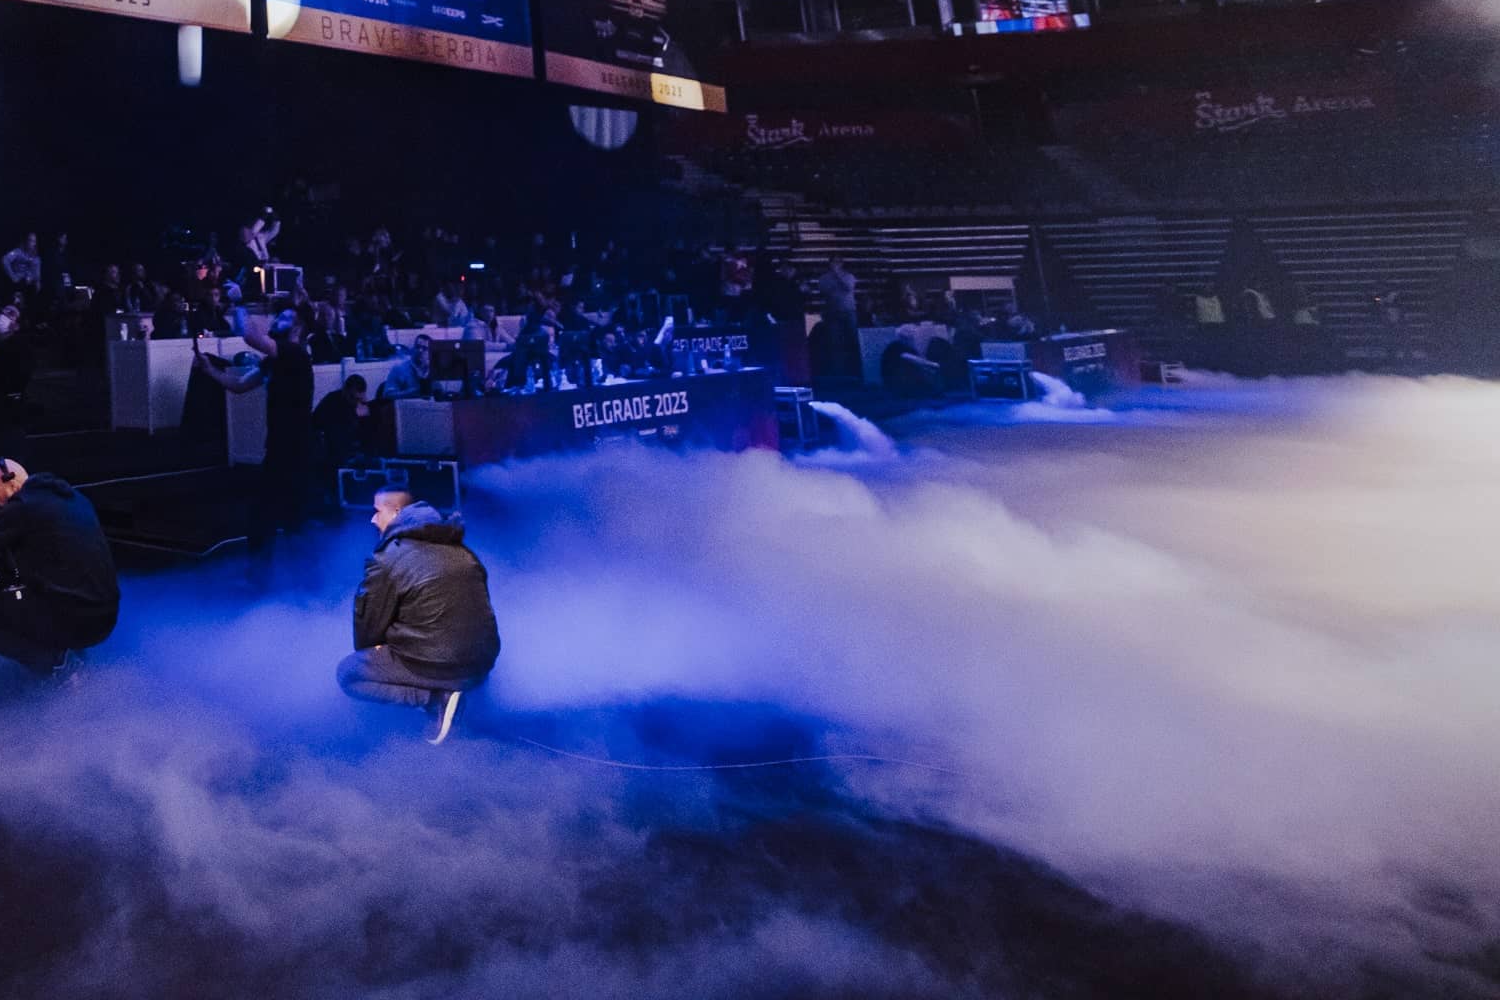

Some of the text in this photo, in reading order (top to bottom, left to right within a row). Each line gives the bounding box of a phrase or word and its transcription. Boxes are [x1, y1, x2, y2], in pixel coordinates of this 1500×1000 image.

[321, 15, 498, 67] BRAVE SERBIA
[818, 120, 876, 137] Arena
[571, 390, 690, 429] BELGRADE 2023
